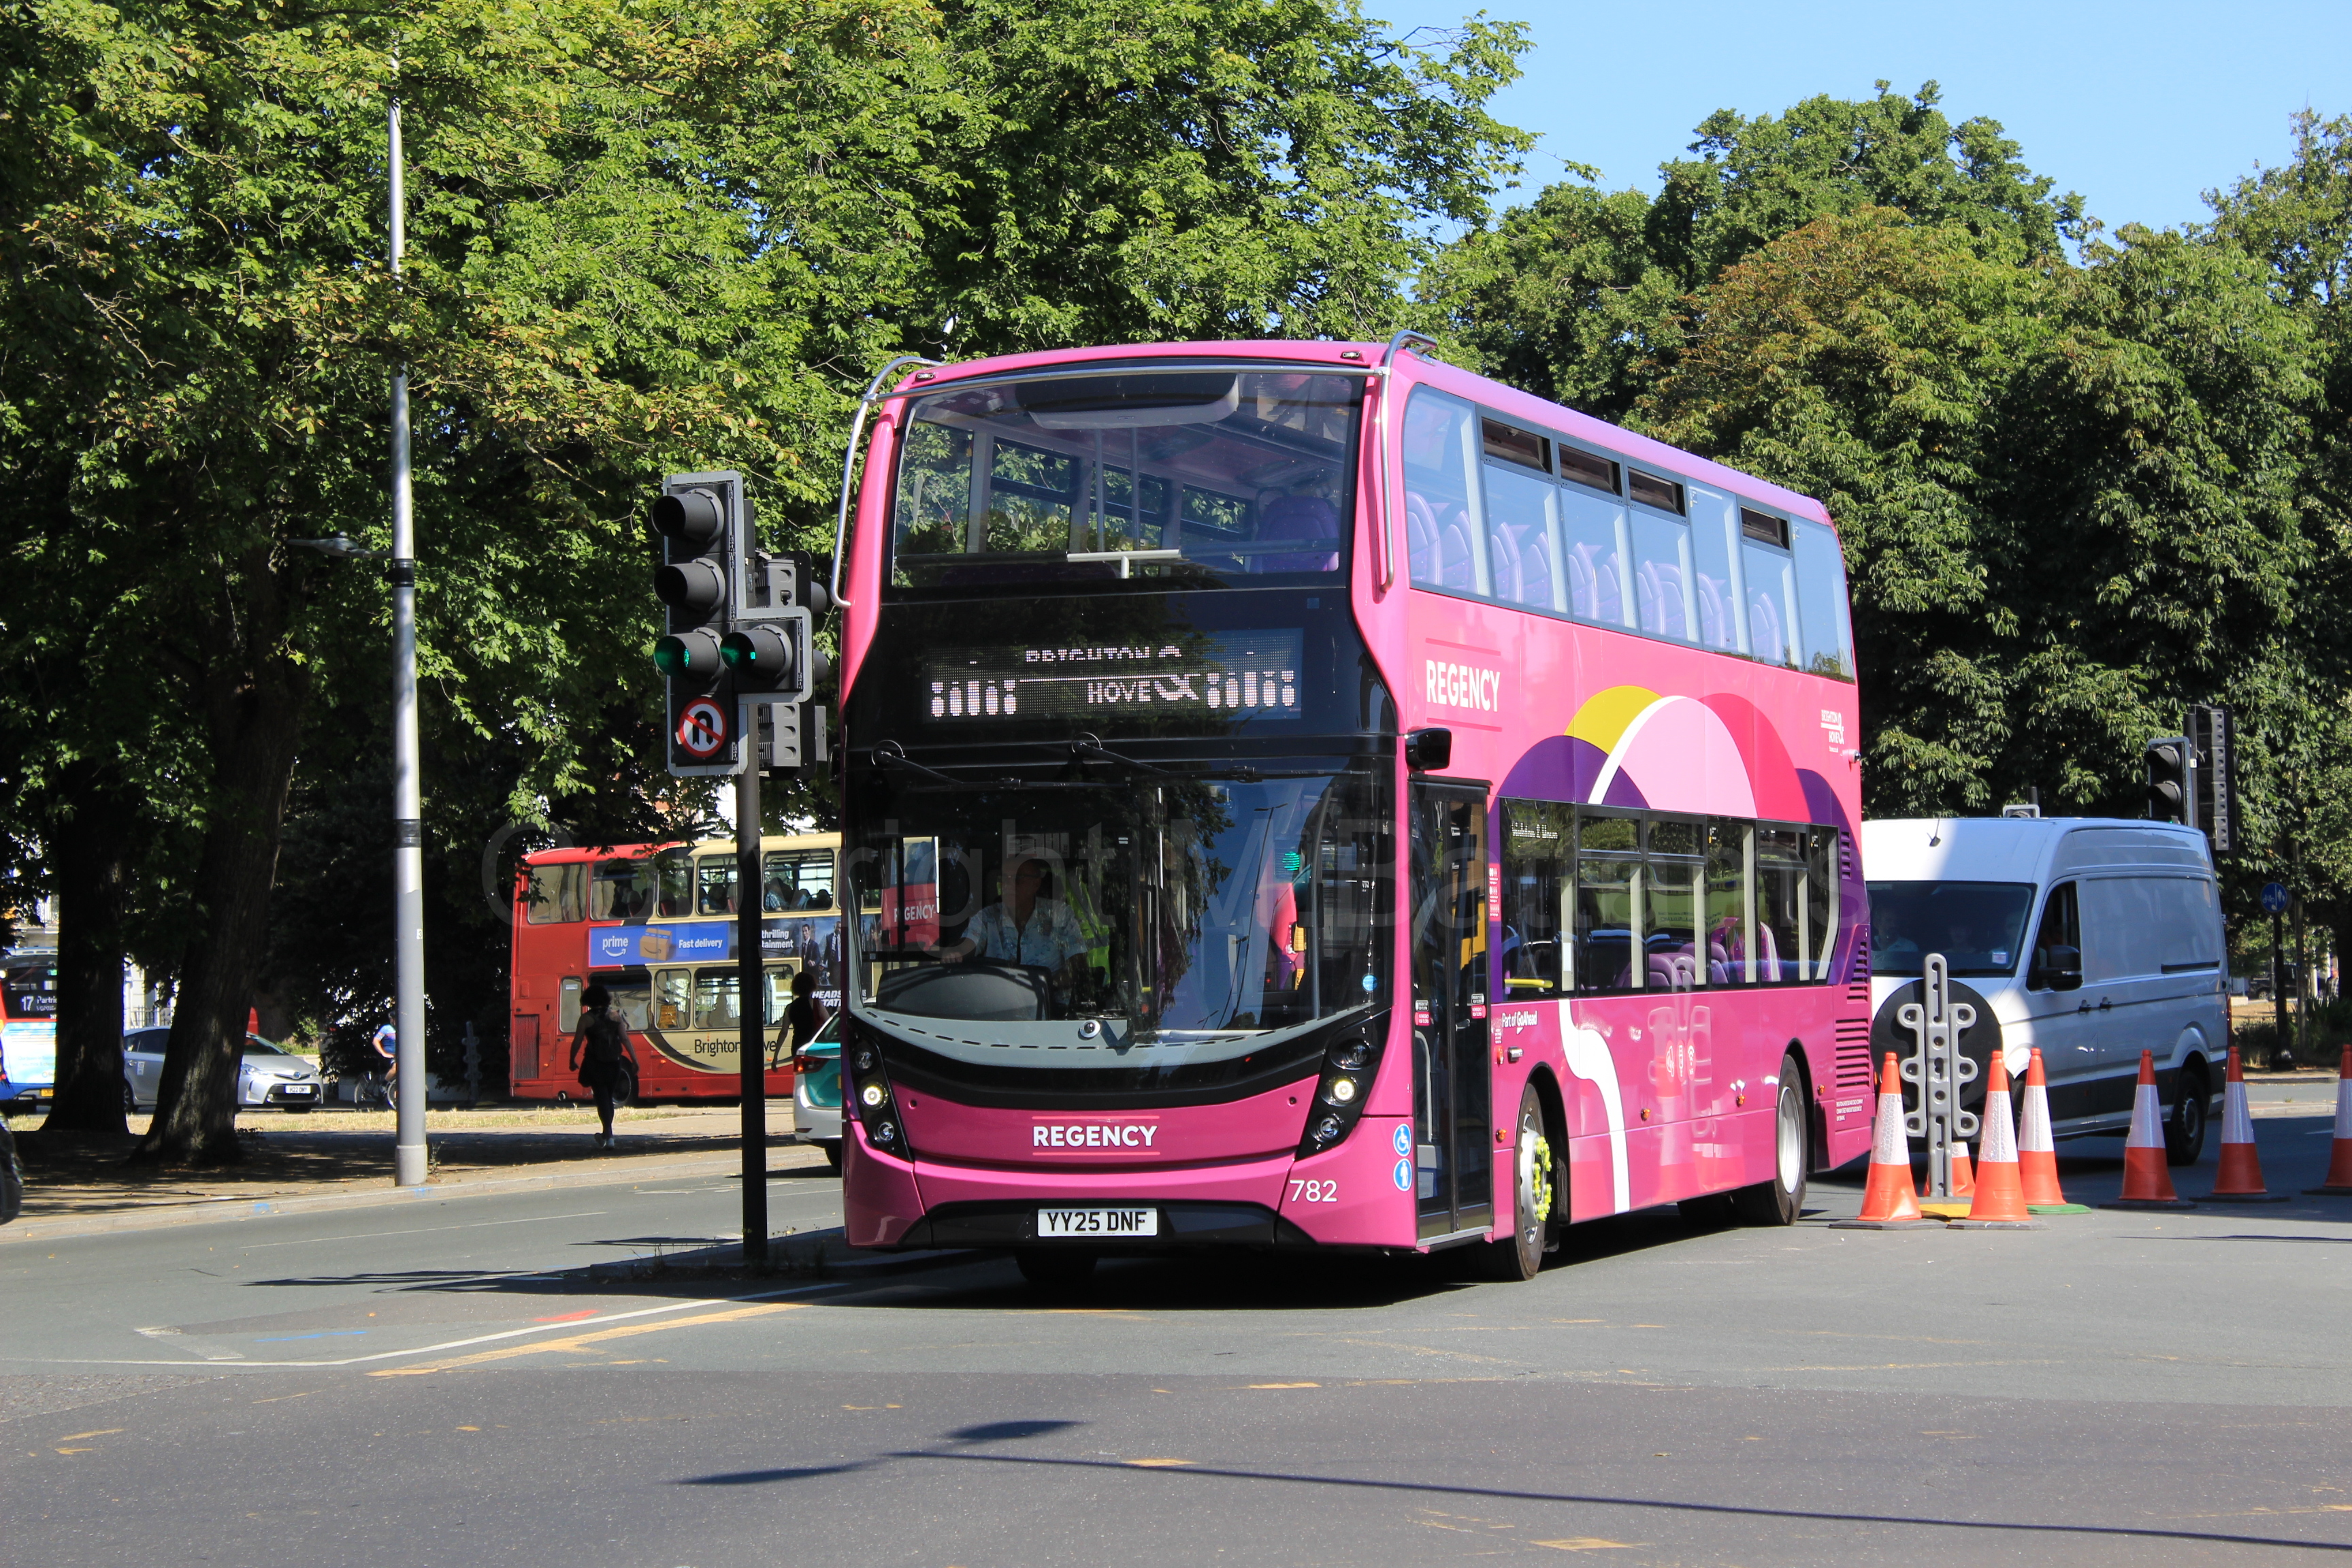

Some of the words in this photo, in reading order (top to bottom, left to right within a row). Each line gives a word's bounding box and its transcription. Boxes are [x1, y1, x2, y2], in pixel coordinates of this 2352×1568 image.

[1088, 681, 1152, 704] HOVE
[1426, 659, 1501, 712] REGENCY
[894, 904, 934, 922] RGENCY
[602, 936, 629, 950] prime
[679, 939, 693, 949] Fast
[695, 938, 723, 949] delivery
[761, 929, 789, 940] thrilling
[761, 939, 794, 949] tainment
[21, 996, 34, 1011] 17
[1502, 1013, 1511, 1028] Part
[1511, 1011, 1516, 1027] of
[694, 1037, 740, 1057] Brighton
[1033, 1126, 1158, 1147] REGENCY
[1290, 1179, 1338, 1203] 782
[1047, 1211, 1100, 1232] YY25
[1107, 1211, 1147, 1231] DNF
